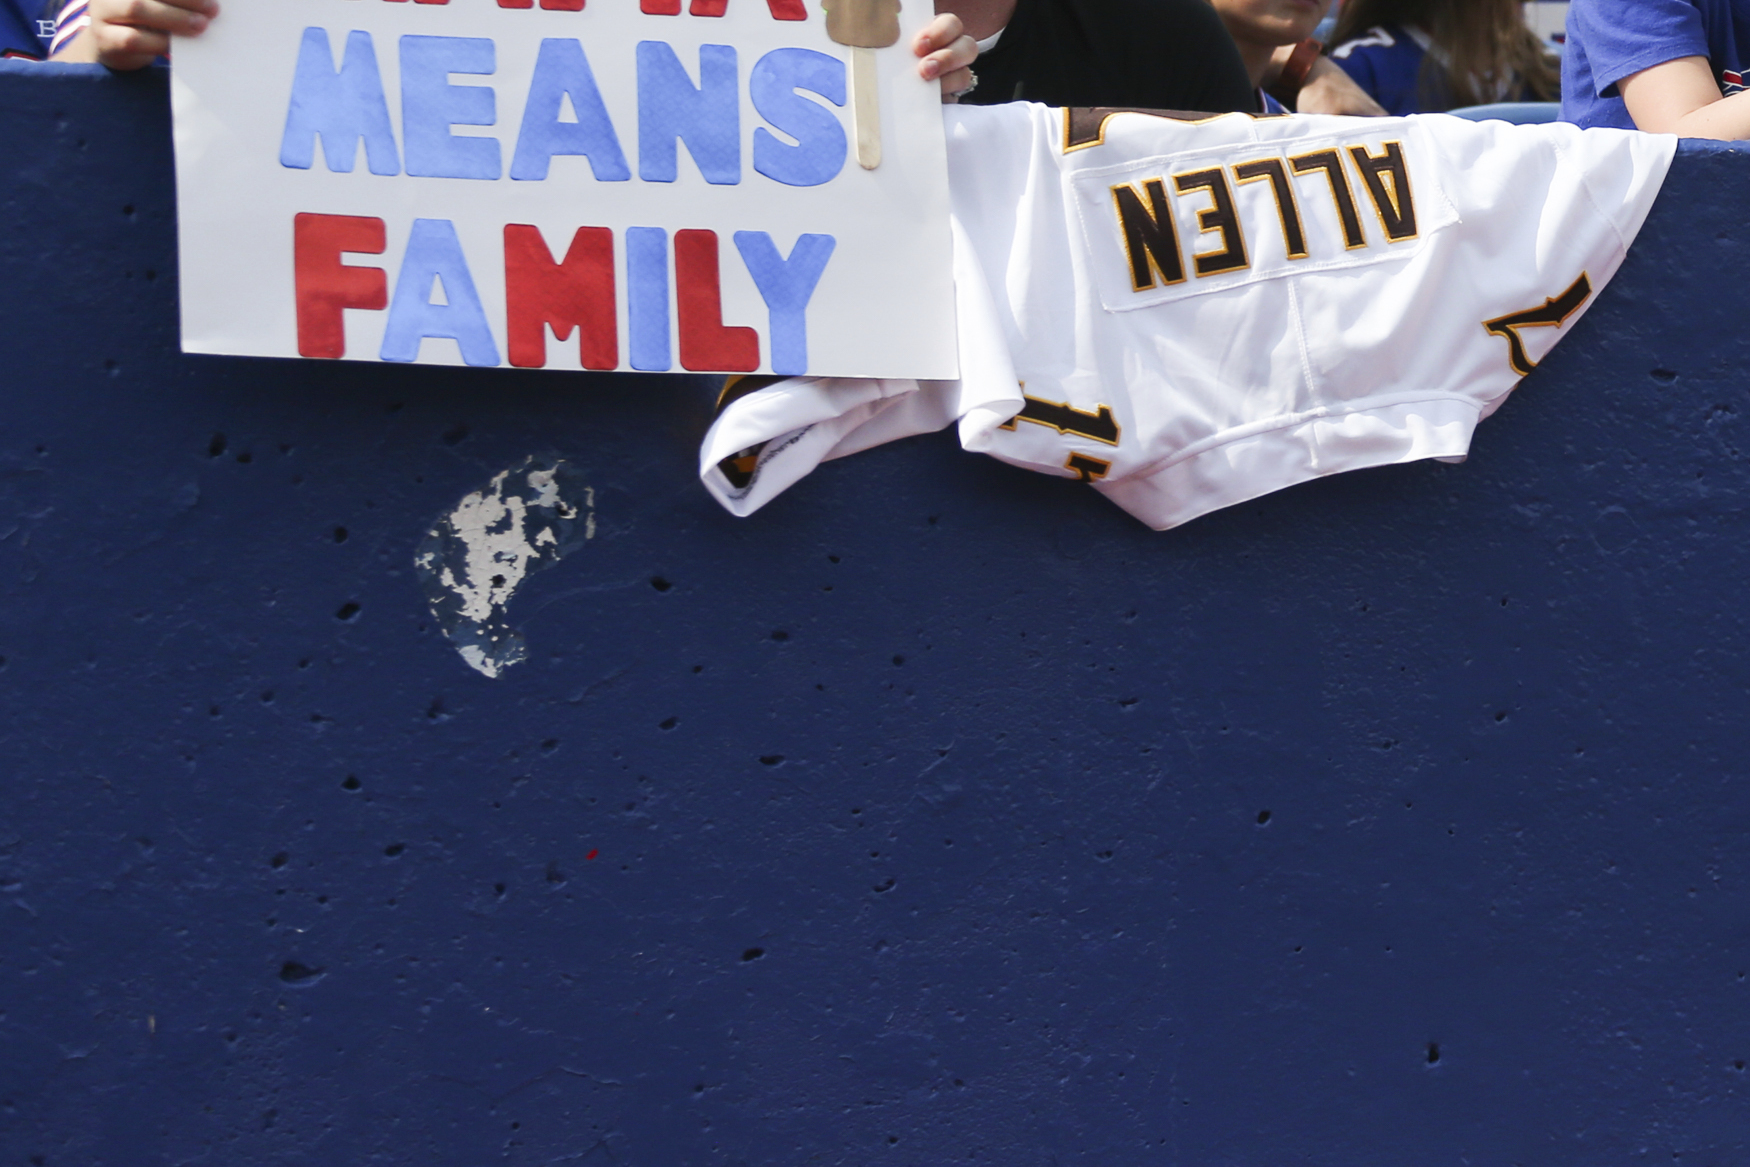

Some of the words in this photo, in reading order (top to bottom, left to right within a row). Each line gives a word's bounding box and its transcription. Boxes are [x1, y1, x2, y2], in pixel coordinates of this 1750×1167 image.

[280, 27, 848, 187] MEANS
[294, 212, 837, 375] FAMILY
[1110, 139, 1419, 292] ALLEN
